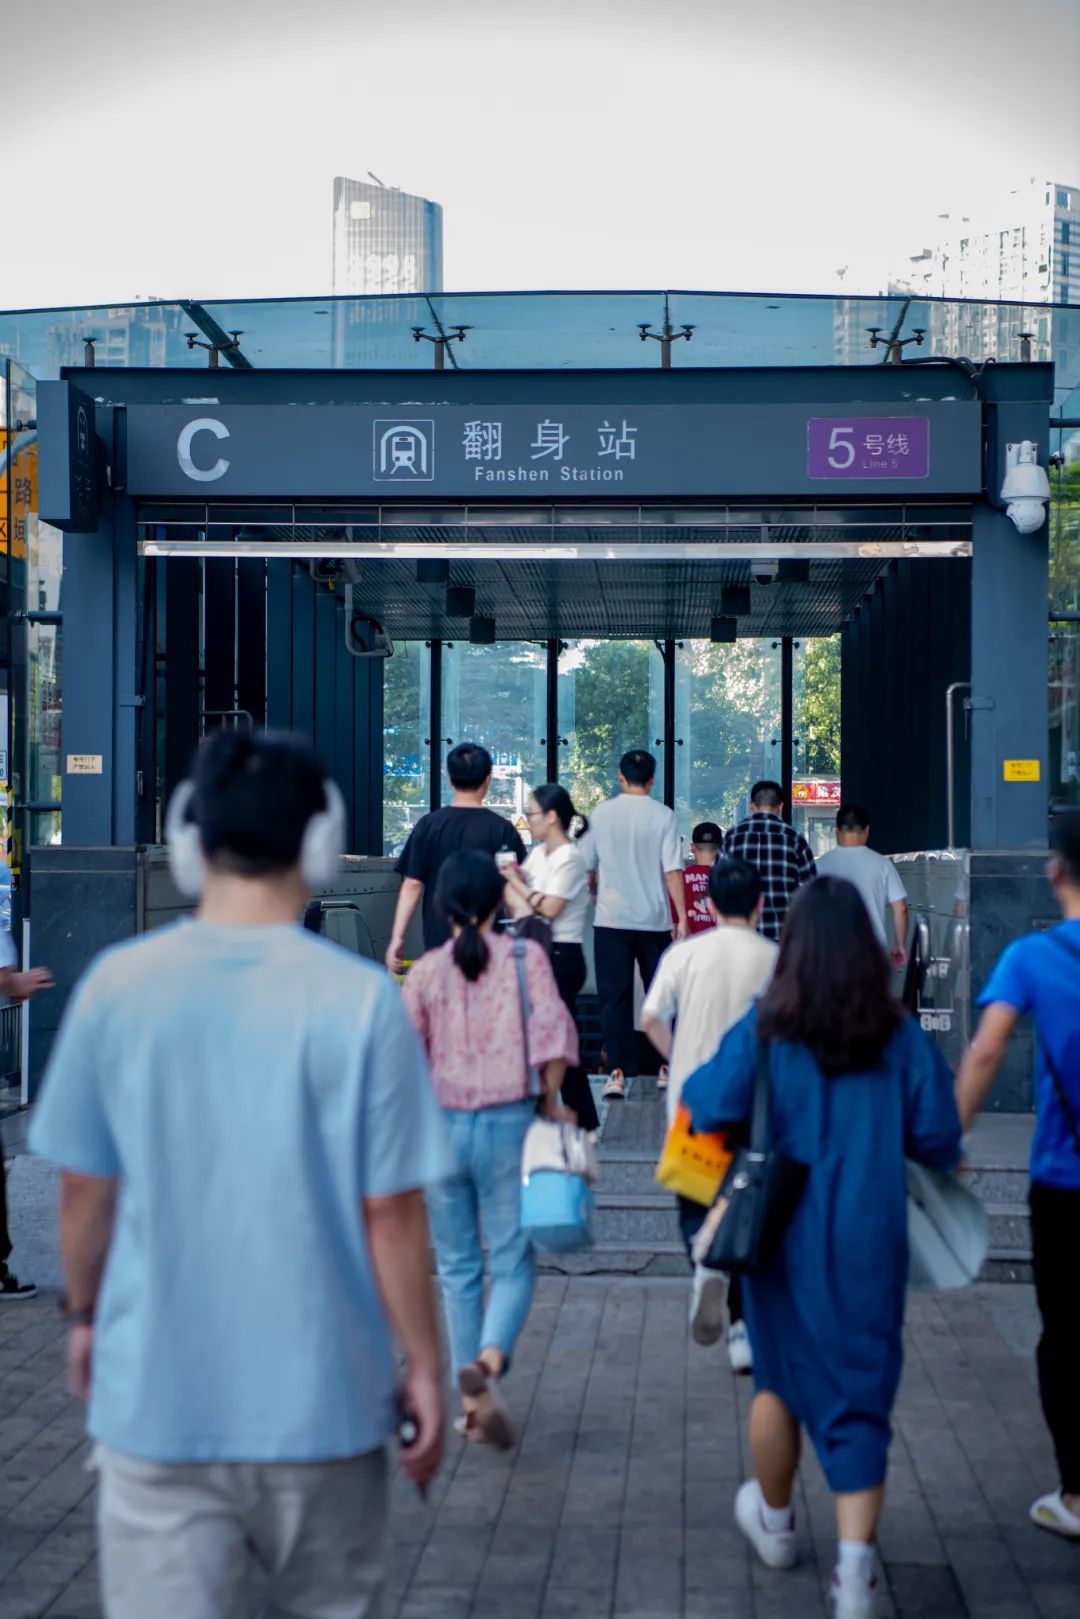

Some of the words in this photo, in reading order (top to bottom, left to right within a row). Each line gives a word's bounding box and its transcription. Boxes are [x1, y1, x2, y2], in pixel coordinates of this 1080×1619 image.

[177, 417, 231, 482] C
[461, 419, 638, 461] 翻身站
[474, 466, 549, 482] Fanshen
[560, 465, 624, 481] Station
[862, 458, 888, 469] Line
[891, 458, 898, 469] 5
